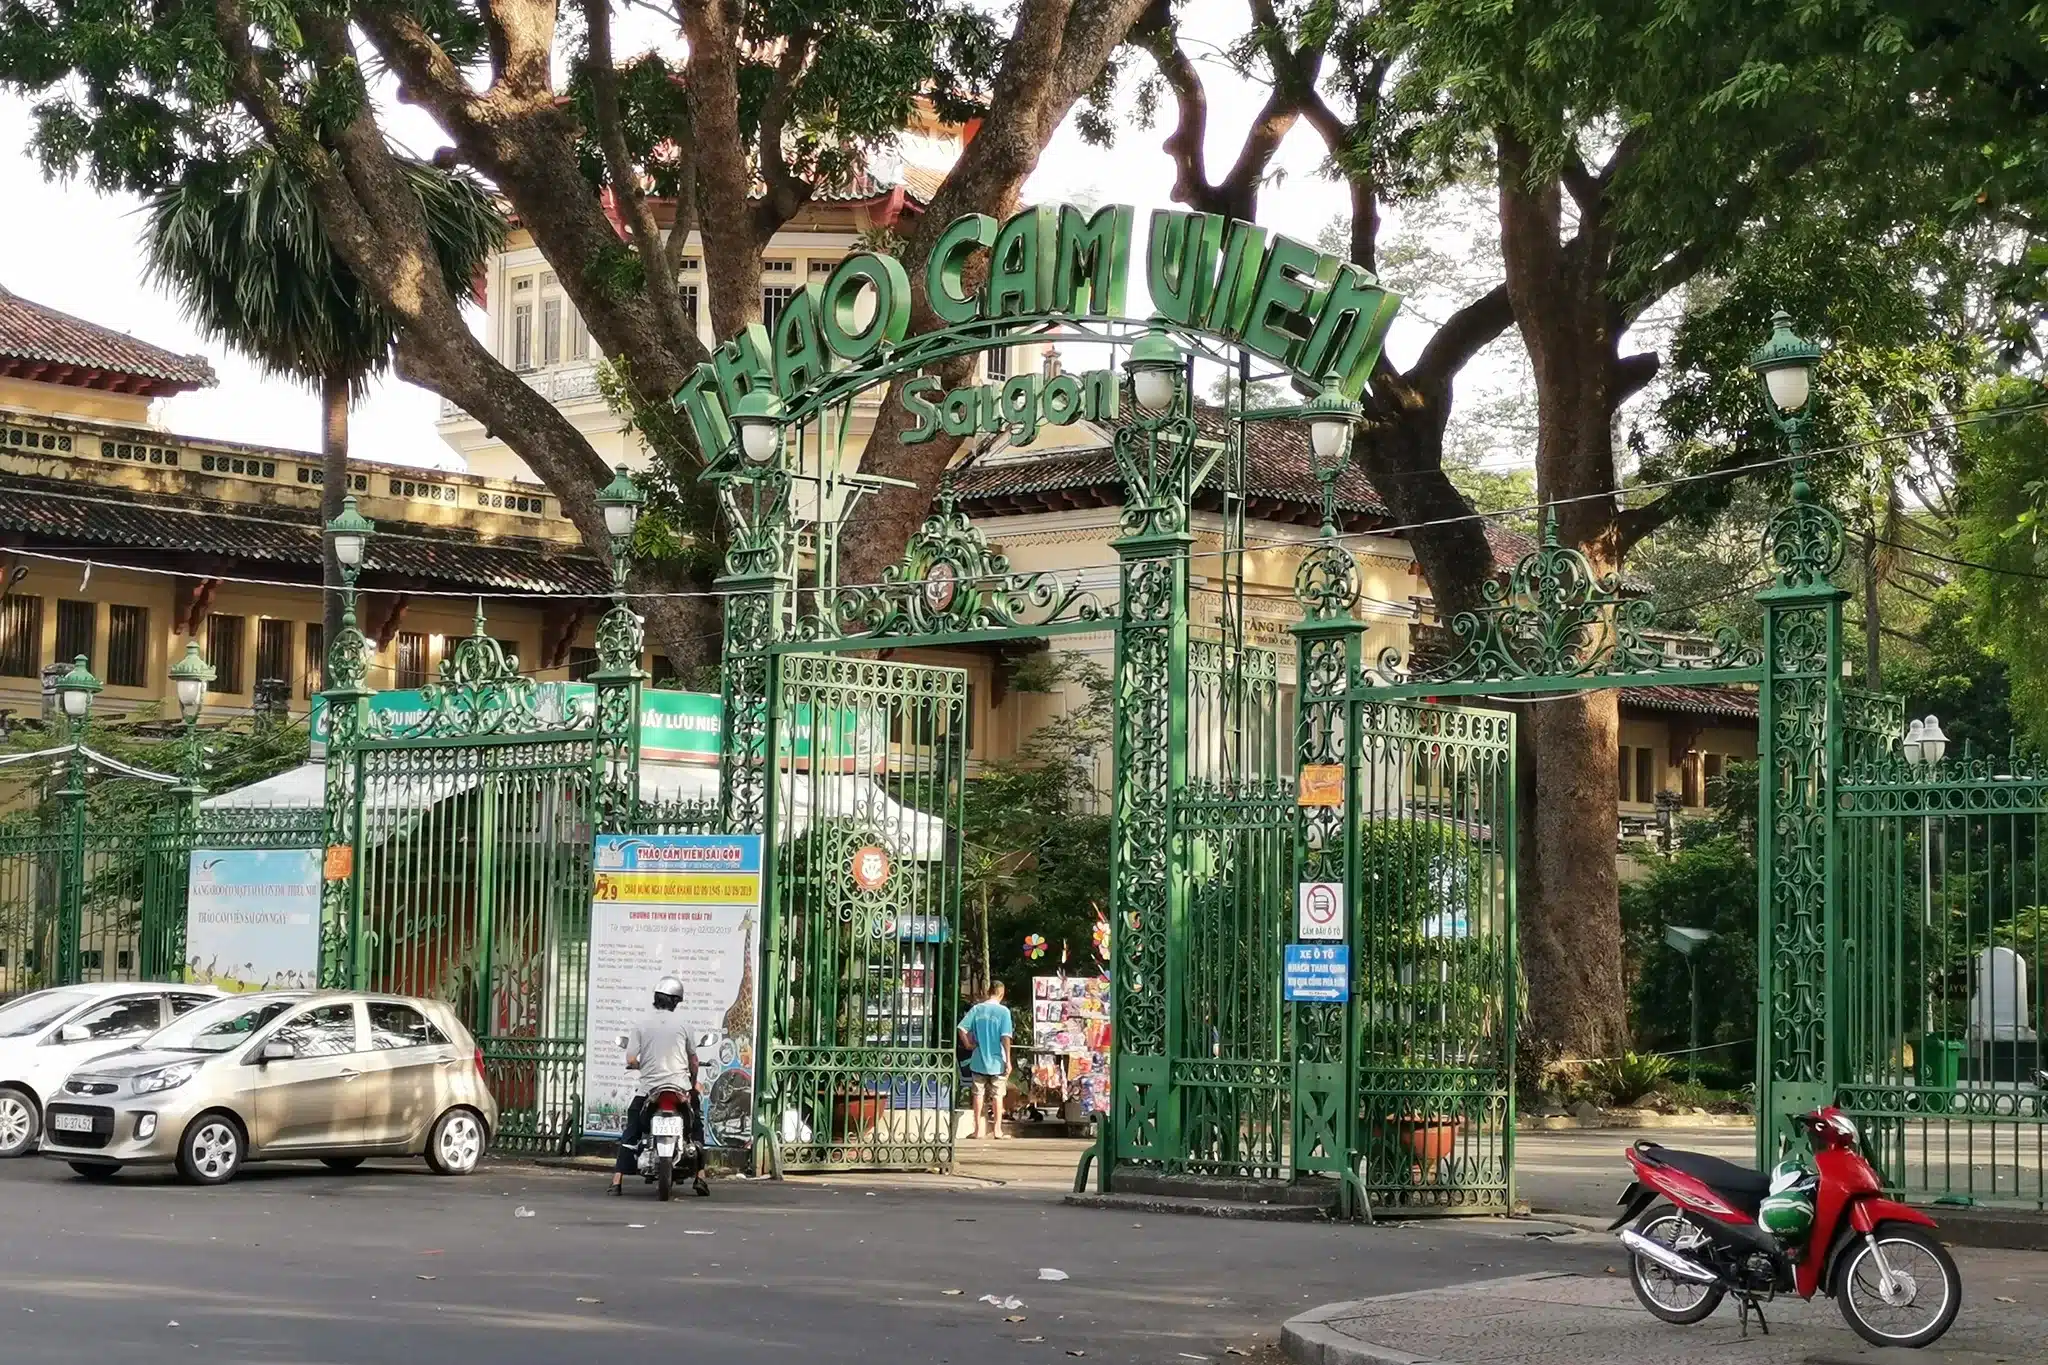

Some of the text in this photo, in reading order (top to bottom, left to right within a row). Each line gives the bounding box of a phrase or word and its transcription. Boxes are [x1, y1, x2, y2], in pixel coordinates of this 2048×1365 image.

[671, 250, 912, 464] THAO
[925, 203, 1135, 325] CAM
[899, 368, 1120, 446] Saigon
[1300, 947, 1335, 959] XE Ô TÔ
